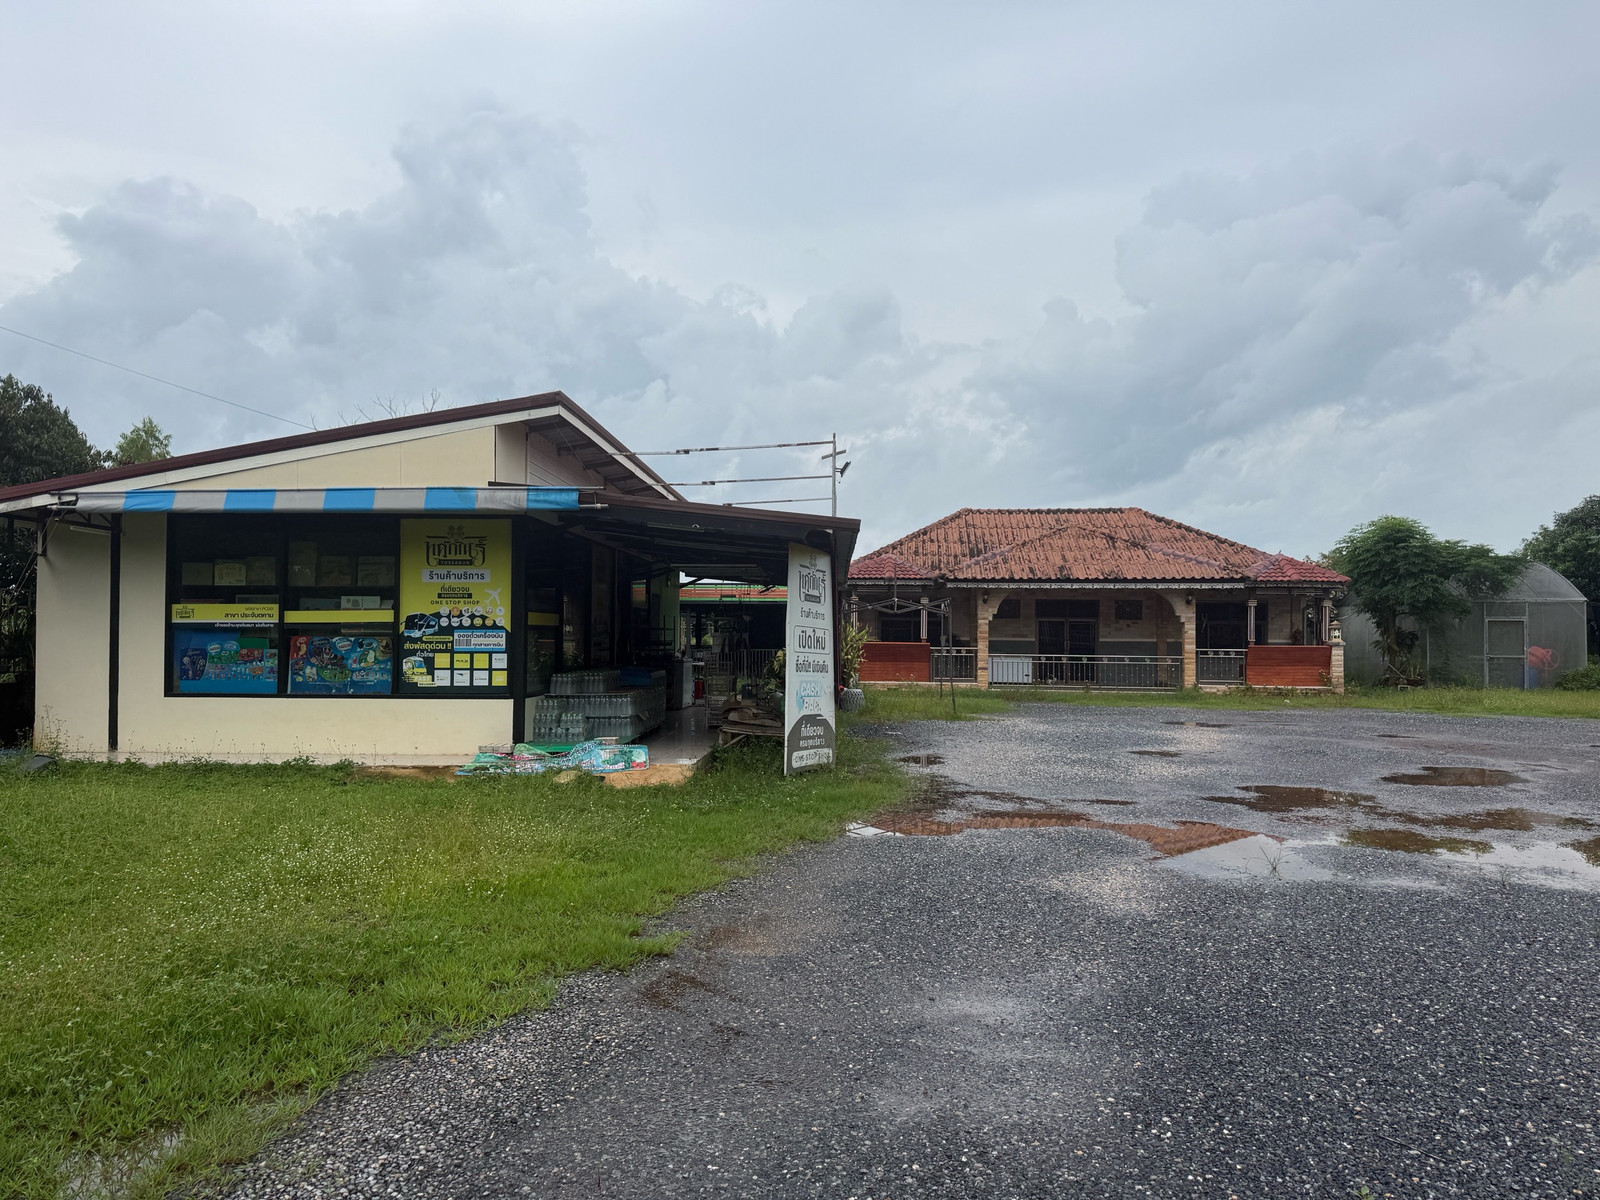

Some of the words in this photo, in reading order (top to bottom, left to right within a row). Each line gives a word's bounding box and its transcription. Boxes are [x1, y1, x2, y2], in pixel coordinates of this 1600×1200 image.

[428, 570, 485, 580] ร้านค้าบริการ
[440, 583, 470, 592] ที่เดียวจบ
[800, 607, 825, 620] ร้านค้าบริการ
[404, 641, 446, 651] ส่งพัสดุด่วน
[798, 629, 826, 650] เปิดใหม่
[800, 682, 819, 696] CASH
[800, 721, 824, 737] ที่เดียวจบ
